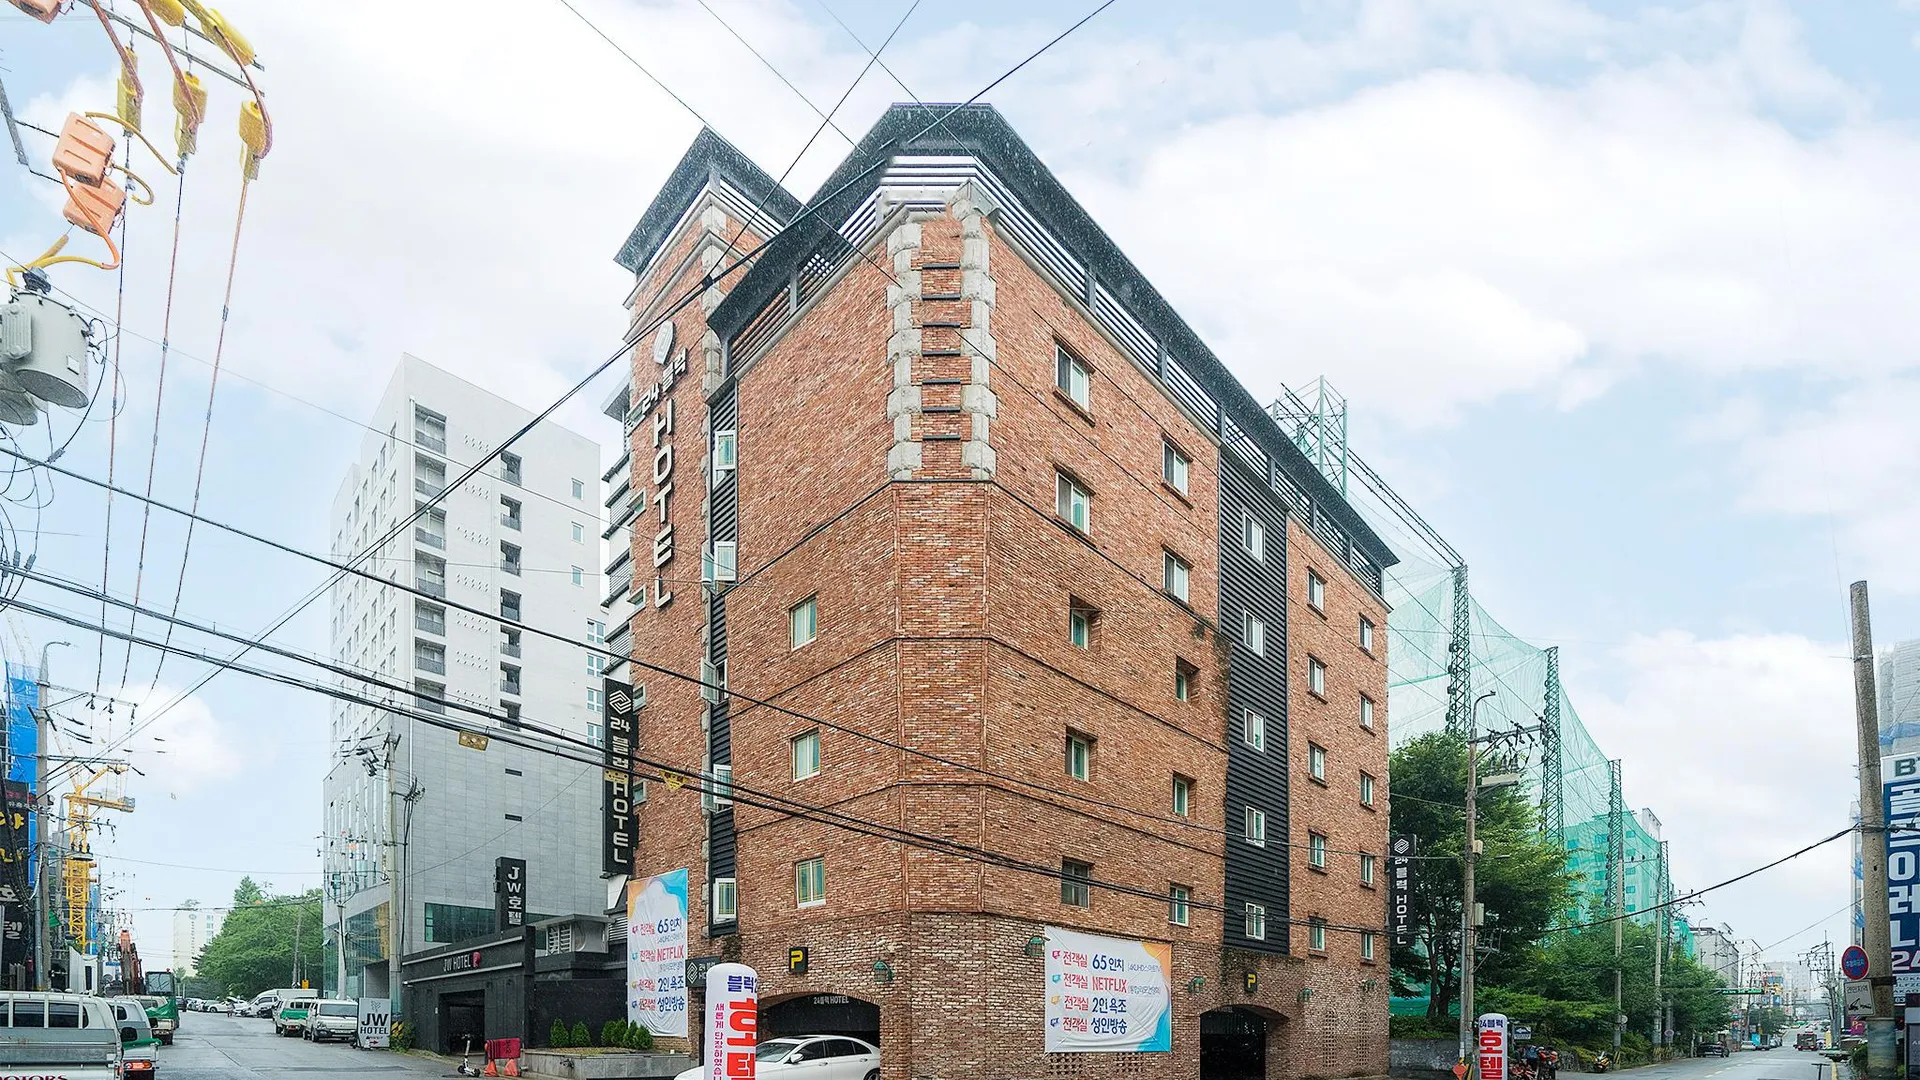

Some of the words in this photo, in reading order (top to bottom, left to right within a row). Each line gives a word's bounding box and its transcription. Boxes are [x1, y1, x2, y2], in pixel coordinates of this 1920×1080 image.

[653, 398, 673, 608] HOTEL
[1396, 894, 1408, 945] HOTEL
[453, 953, 471, 971] HOTEL
[656, 945, 684, 962] NETFLIX
[791, 950, 804, 970] P
[1063, 951, 1088, 968] 전객실
[1063, 973, 1088, 989] 전객실
[1092, 976, 1127, 994] NETFLIX
[1064, 995, 1089, 1011] 전객실
[361, 1013, 389, 1026] JW
[1063, 1016, 1088, 1032] 전객실
[1090, 1017, 1128, 1034] 성인방송
[360, 1026, 389, 1035] HOTEL
